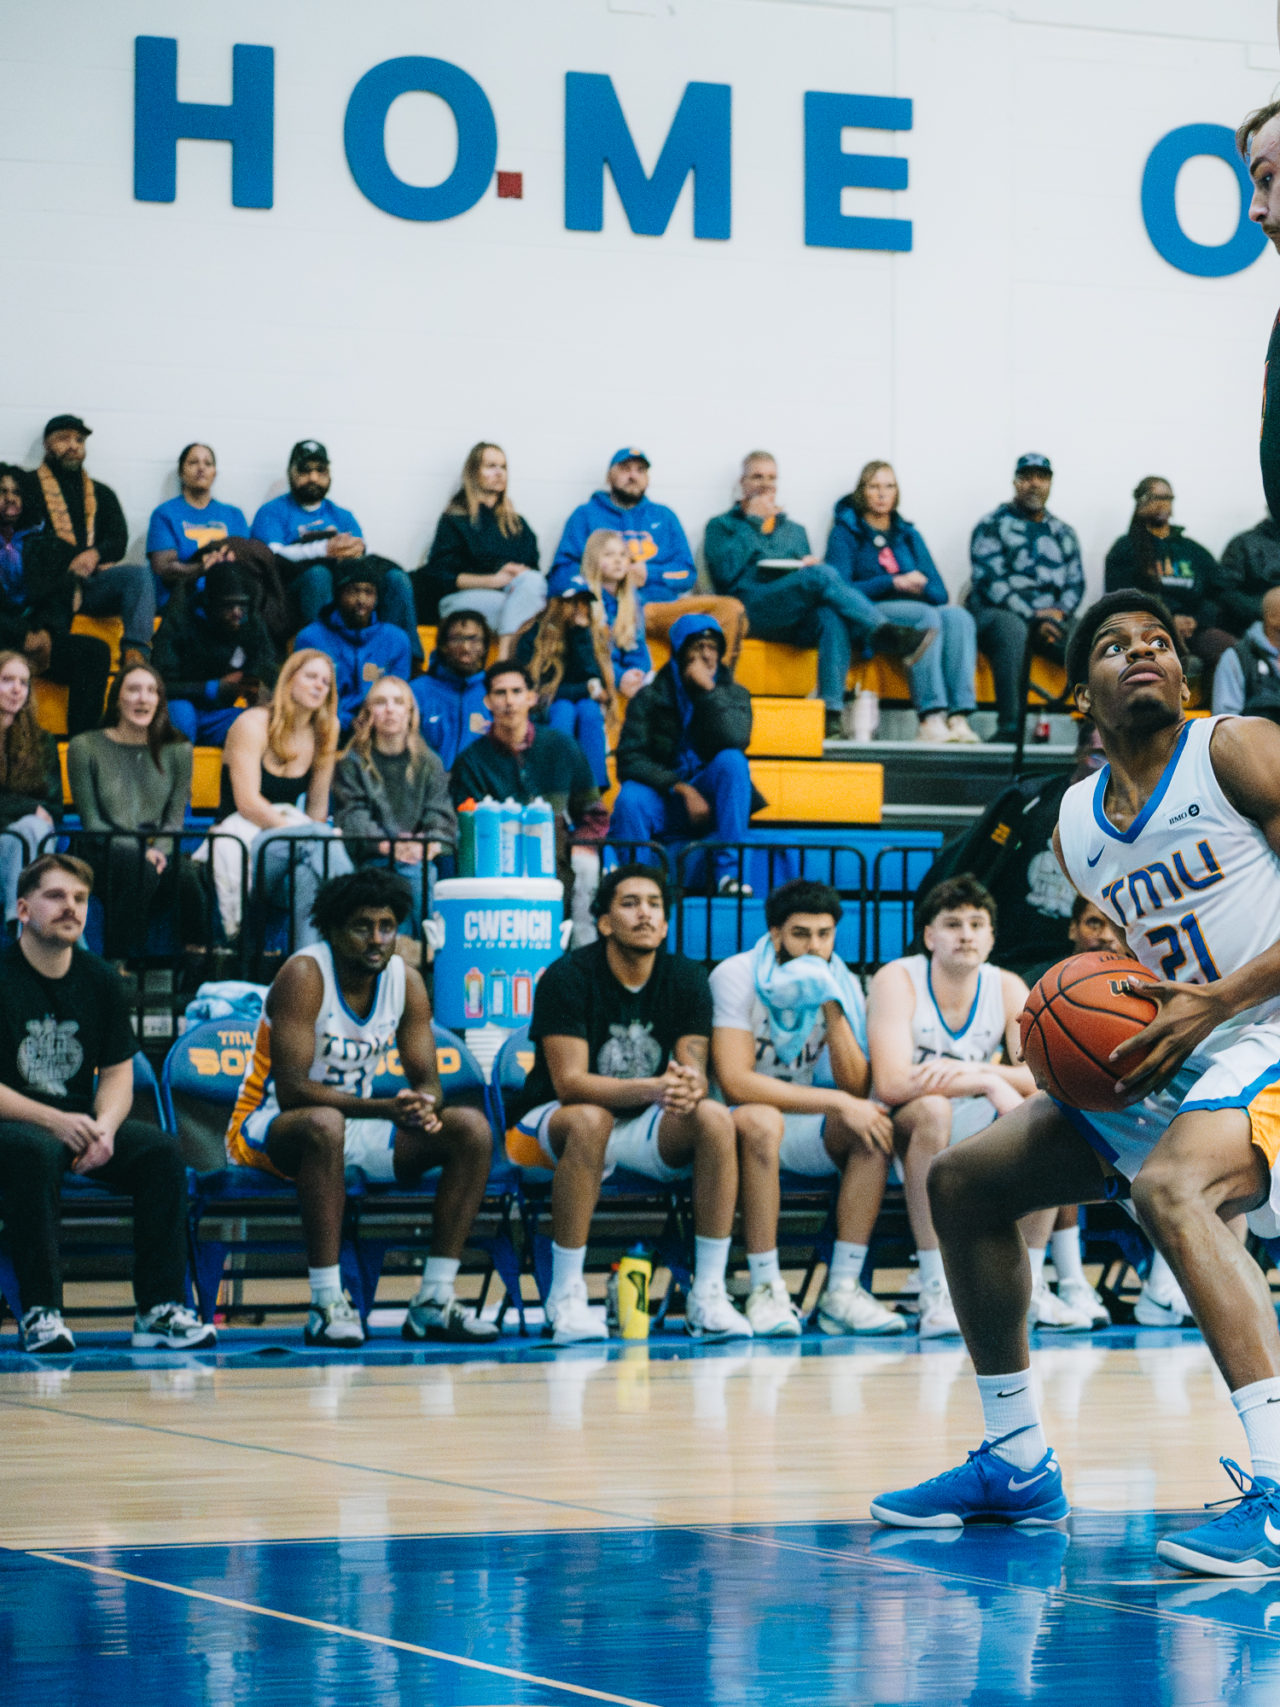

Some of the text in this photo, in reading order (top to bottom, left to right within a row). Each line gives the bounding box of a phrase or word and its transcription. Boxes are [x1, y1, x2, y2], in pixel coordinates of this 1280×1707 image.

[134, 35, 912, 252] HOME
[1141, 123, 1269, 278] O
[1169, 811, 1188, 825] BMO
[1101, 839, 1225, 926] TMU
[464, 909, 552, 941] CWENCH
[1144, 909, 1222, 984] 21
